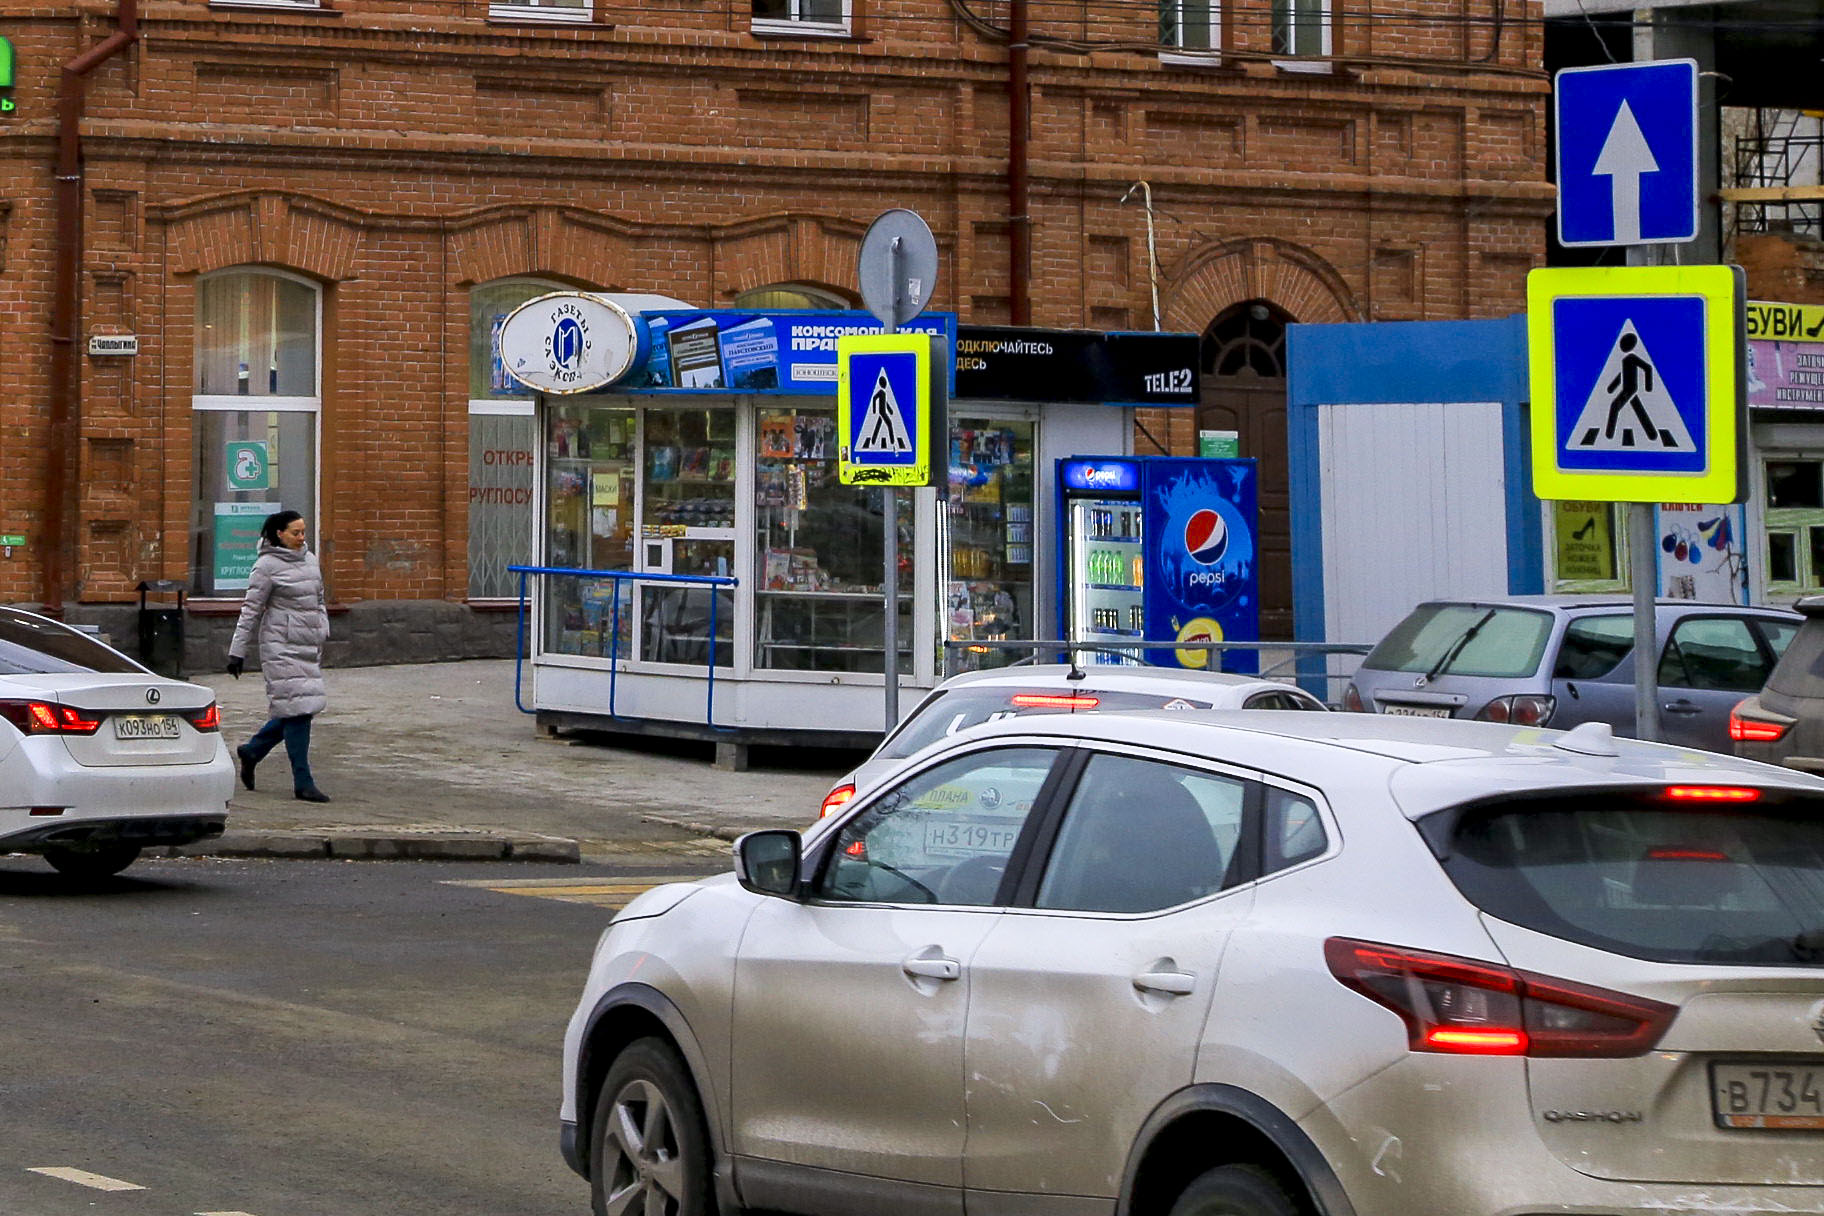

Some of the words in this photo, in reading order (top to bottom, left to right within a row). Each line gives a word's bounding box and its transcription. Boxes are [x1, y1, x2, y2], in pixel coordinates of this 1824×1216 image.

[550, 303, 590, 335] ГАЗЕТЫ
[1746, 307, 1803, 337] БУВИ
[791, 325, 938, 337] КОМСОМОЛКАЯ
[791, 337, 839, 351] ПРА
[956, 338, 1054, 355] ОДКЛЮЧАЙТЕСЬ
[956, 357, 987, 371] ДЕСЬ
[1144, 368, 1193, 393] TELE2
[1789, 371, 1824, 386] РЕЖУЩЕ
[1776, 388, 1824, 402] ИНСТРУМЕН
[1095, 469, 1116, 482] pepsi
[469, 487, 533, 505] РУГЛОСУ
[1189, 570, 1225, 587] pepsi
[932, 825, 1015, 848] Н319ТР
[1728, 1071, 1823, 1114] В734
[1543, 1110, 1643, 1124] QASHQAI
